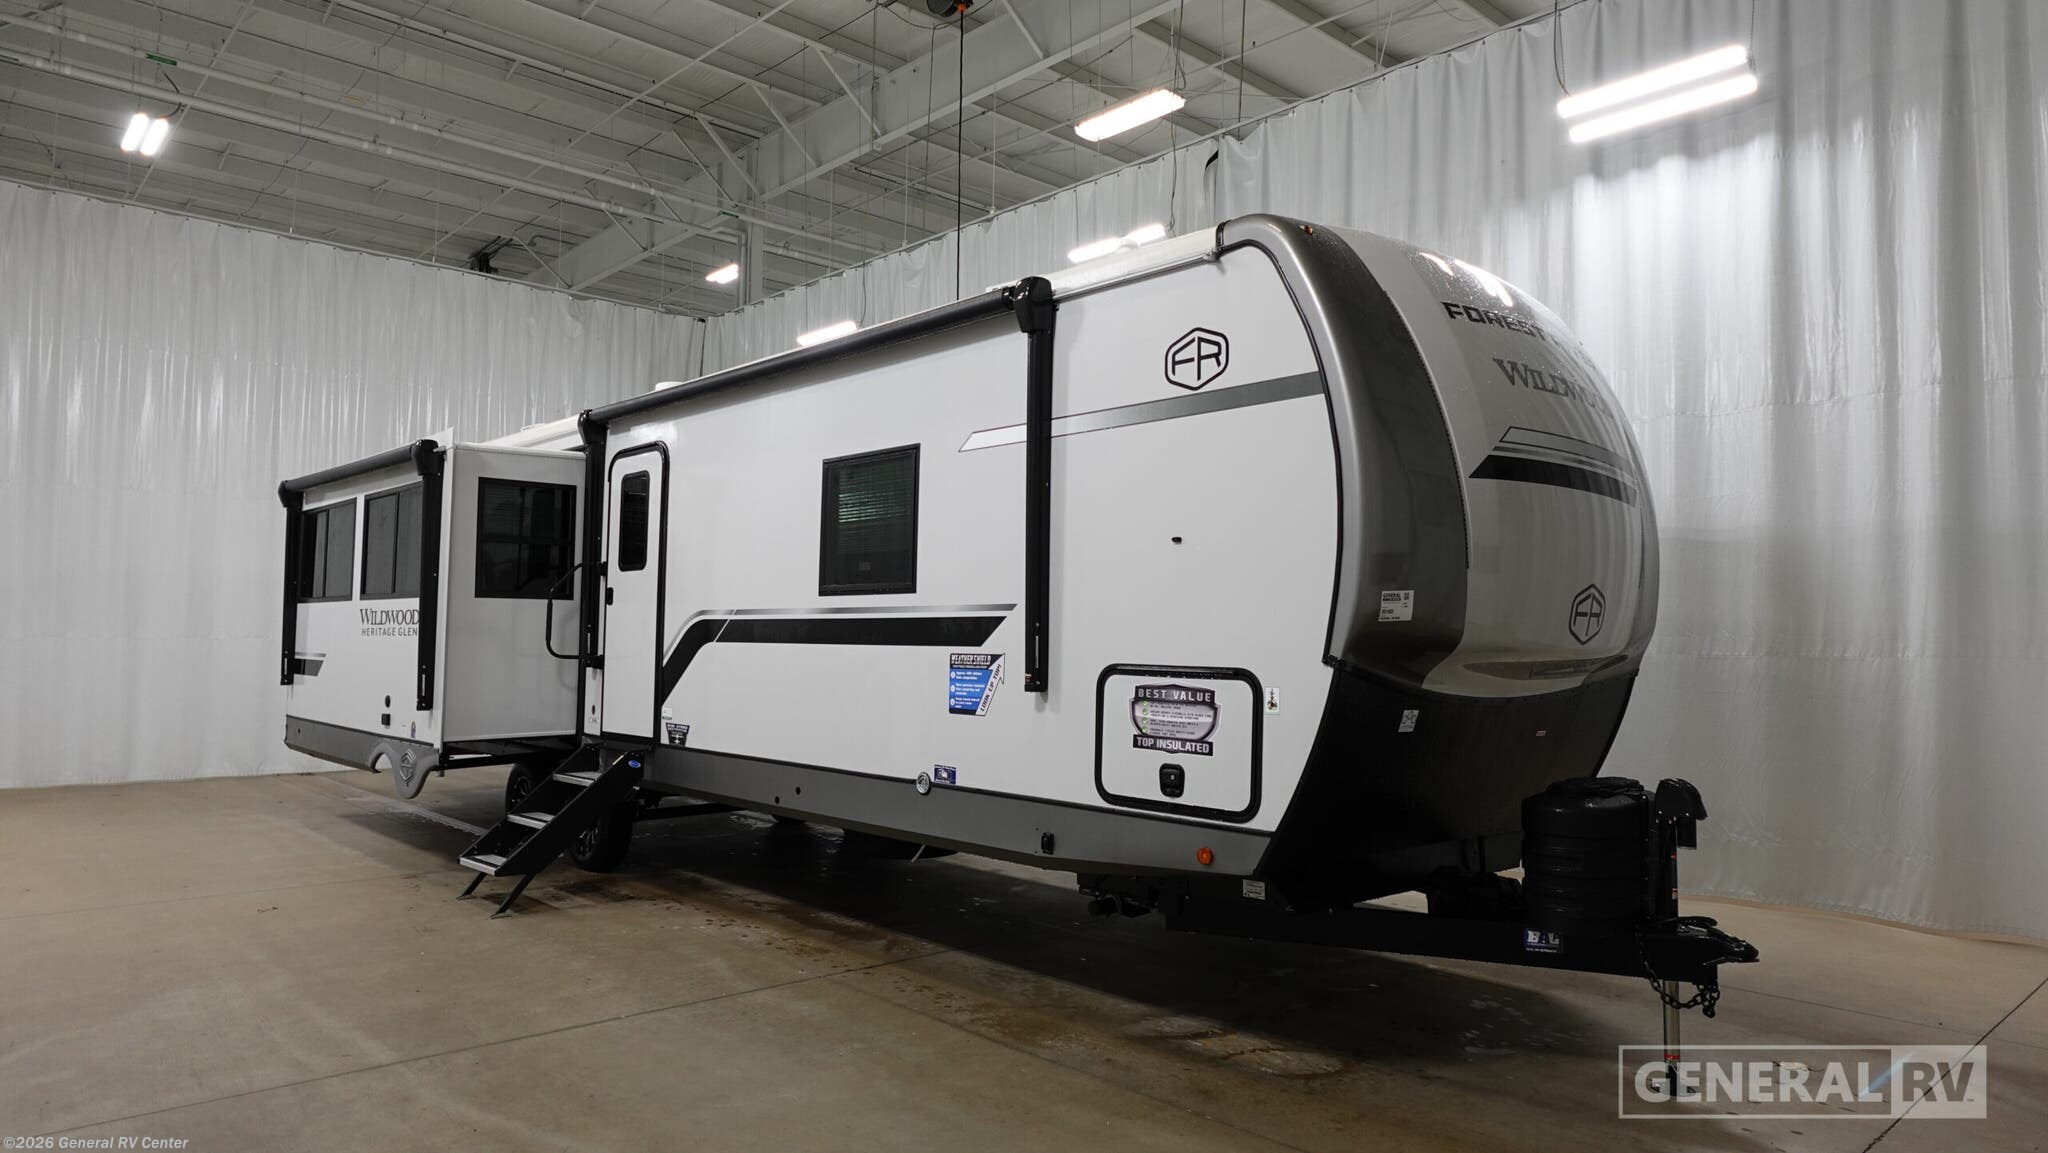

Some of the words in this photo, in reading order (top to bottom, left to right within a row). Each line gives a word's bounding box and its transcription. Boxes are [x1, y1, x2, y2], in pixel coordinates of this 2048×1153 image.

[1171, 335, 1222, 382] FR
[360, 608, 420, 626] WILDWOOD
[361, 627, 396, 637] HERITAGE
[398, 627, 418, 637] GLEN
[1138, 689, 1167, 699] BEST
[1173, 690, 1211, 701] VALUE
[1137, 736, 1154, 748] TOP
[1156, 737, 1210, 753] INSULATED
